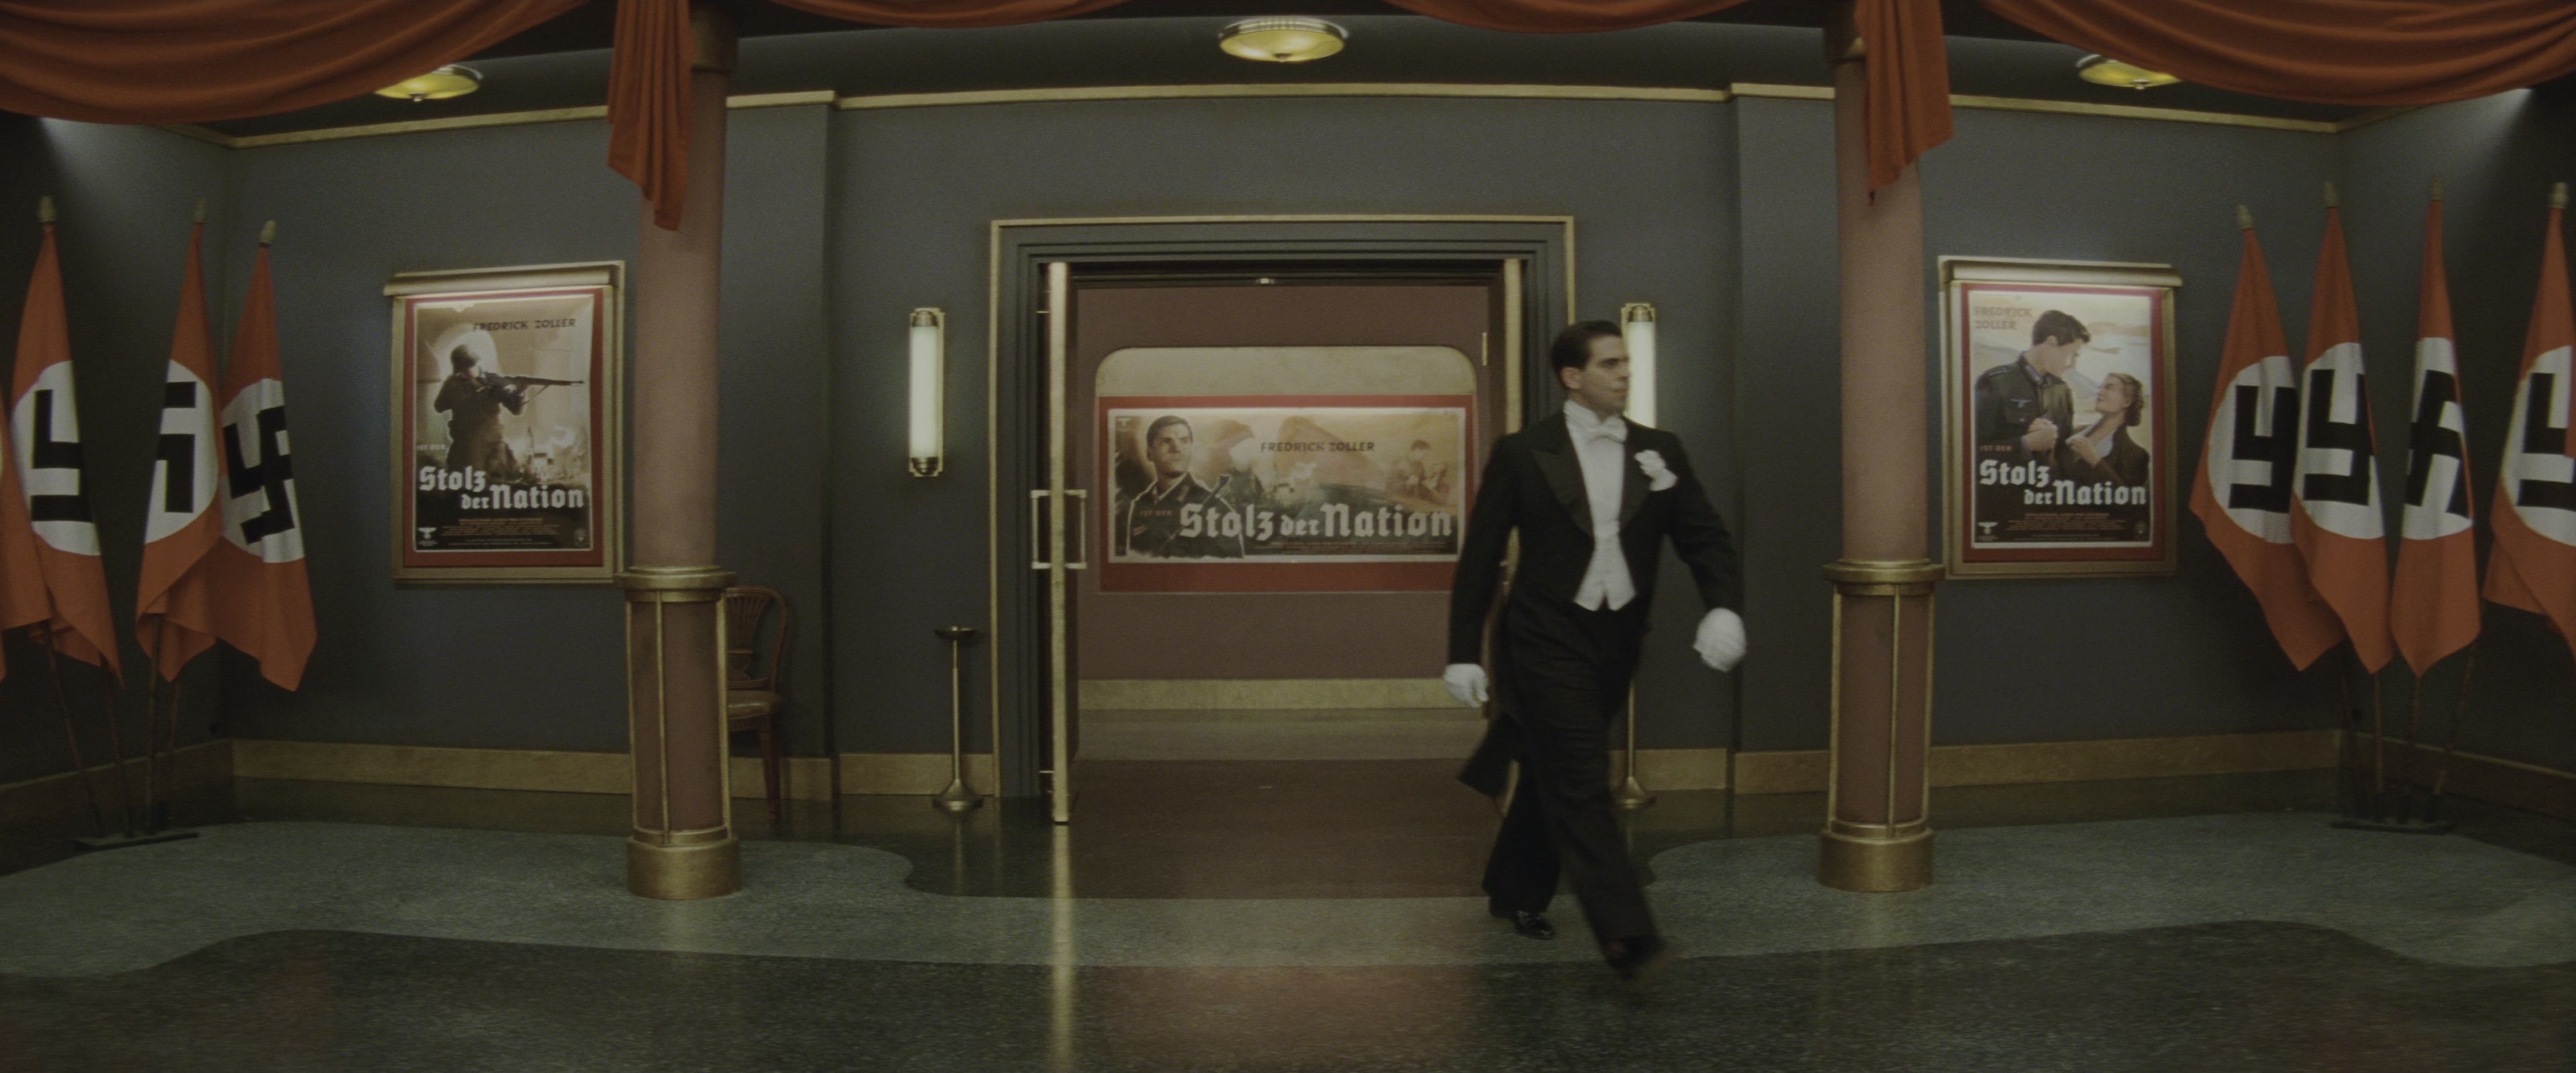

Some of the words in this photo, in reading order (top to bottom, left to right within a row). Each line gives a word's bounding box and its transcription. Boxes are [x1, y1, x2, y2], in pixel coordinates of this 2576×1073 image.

[473, 321, 529, 331] FREDRICK
[535, 319, 576, 329] ZOLLER
[1260, 442, 1325, 452] FREDRICK
[1328, 441, 1375, 451] ZOLLER
[419, 465, 486, 492] Stolz
[1980, 459, 2050, 488] Stolz
[461, 494, 490, 509] der
[489, 484, 584, 509] Nation
[2024, 489, 2053, 505] der
[2052, 479, 2146, 505] Nation
[1179, 503, 1275, 541] Stolz
[1280, 514, 1320, 536] der
[1320, 503, 1452, 537] Nation
